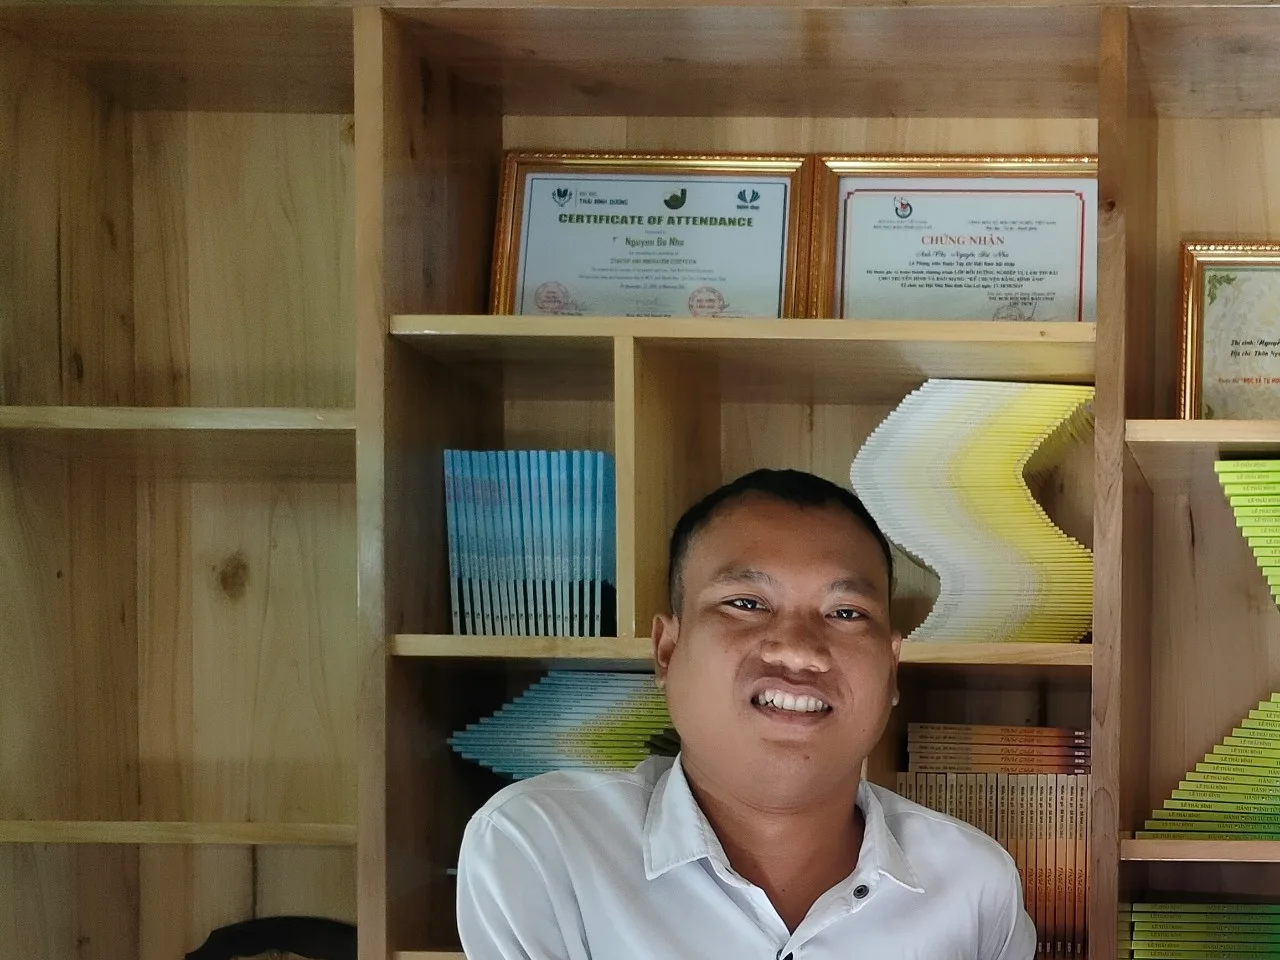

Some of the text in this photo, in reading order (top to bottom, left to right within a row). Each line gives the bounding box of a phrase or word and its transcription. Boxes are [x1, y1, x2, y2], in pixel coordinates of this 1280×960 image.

[558, 213, 754, 227] CERTIFICATE OF ATTENDANCE
[921, 233, 1005, 248] CHỨNG NHẬN
